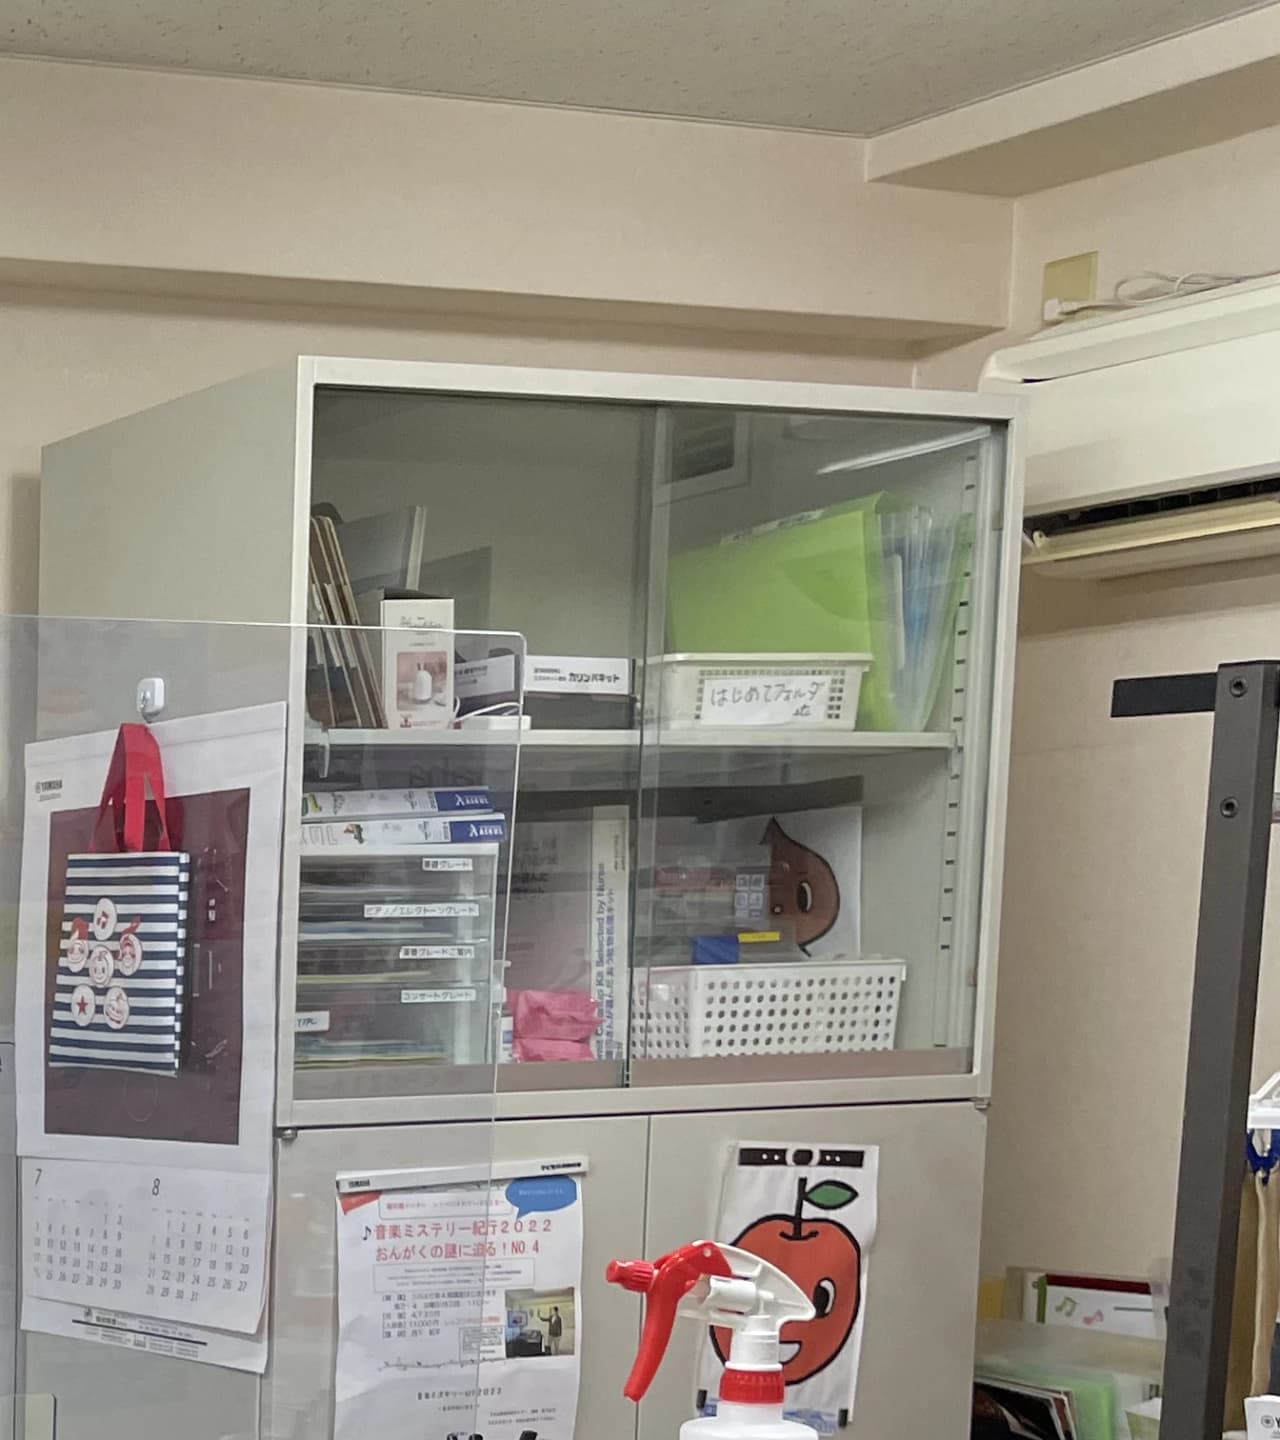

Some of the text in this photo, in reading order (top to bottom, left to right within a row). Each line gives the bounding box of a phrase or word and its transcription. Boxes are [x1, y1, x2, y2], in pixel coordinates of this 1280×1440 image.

[568, 672, 620, 684] カリンバキット
[709, 681, 826, 707] はじめてフォルダ
[595, 917, 605, 967] Selected
[34, 1168, 42, 1186] 7
[151, 1178, 161, 1196] 8
[375, 1219, 552, 1240] 音楽ミステリー紀行2022
